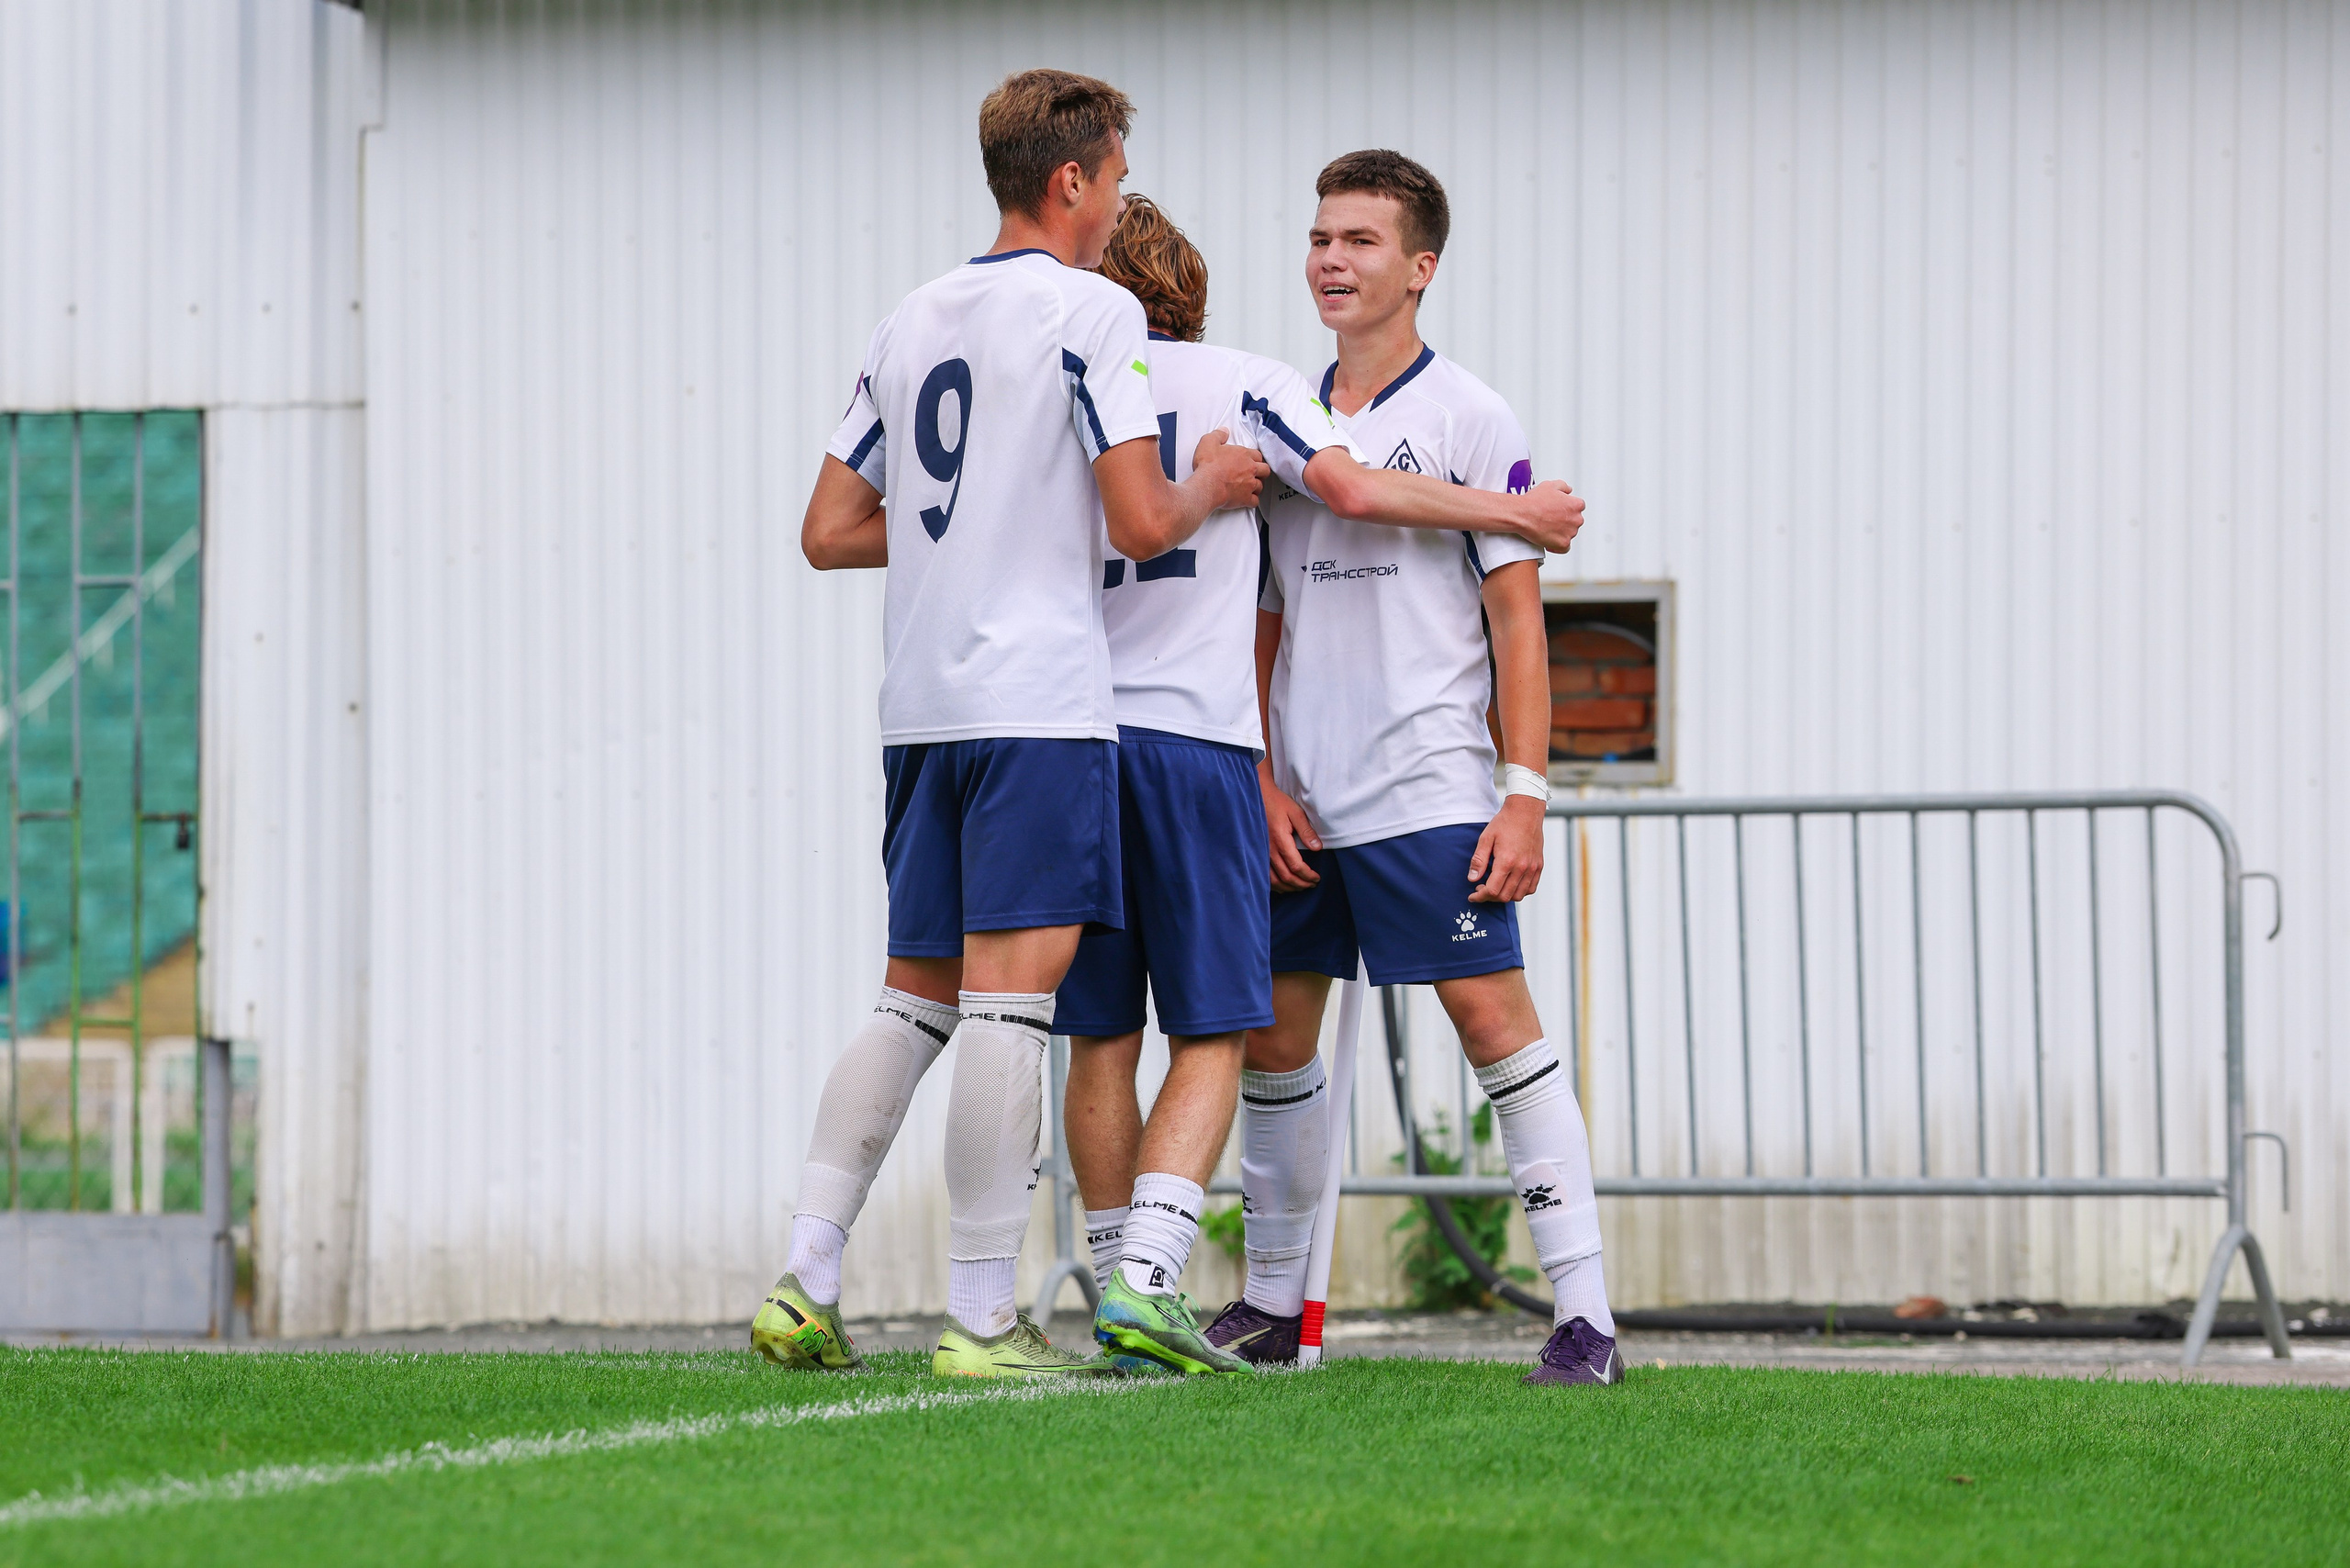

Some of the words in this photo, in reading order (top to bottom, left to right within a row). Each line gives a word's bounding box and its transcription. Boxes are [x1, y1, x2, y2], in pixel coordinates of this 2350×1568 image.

[914, 357, 973, 544] 9
[1102, 410, 1197, 589] 1
[1311, 559, 1337, 572] ДСК
[1311, 564, 1399, 583] ТРАНССТРОЙ
[1451, 929, 1488, 942] KELME
[1524, 1199, 1562, 1213] KELME
[1094, 1230, 1123, 1243] KEL
